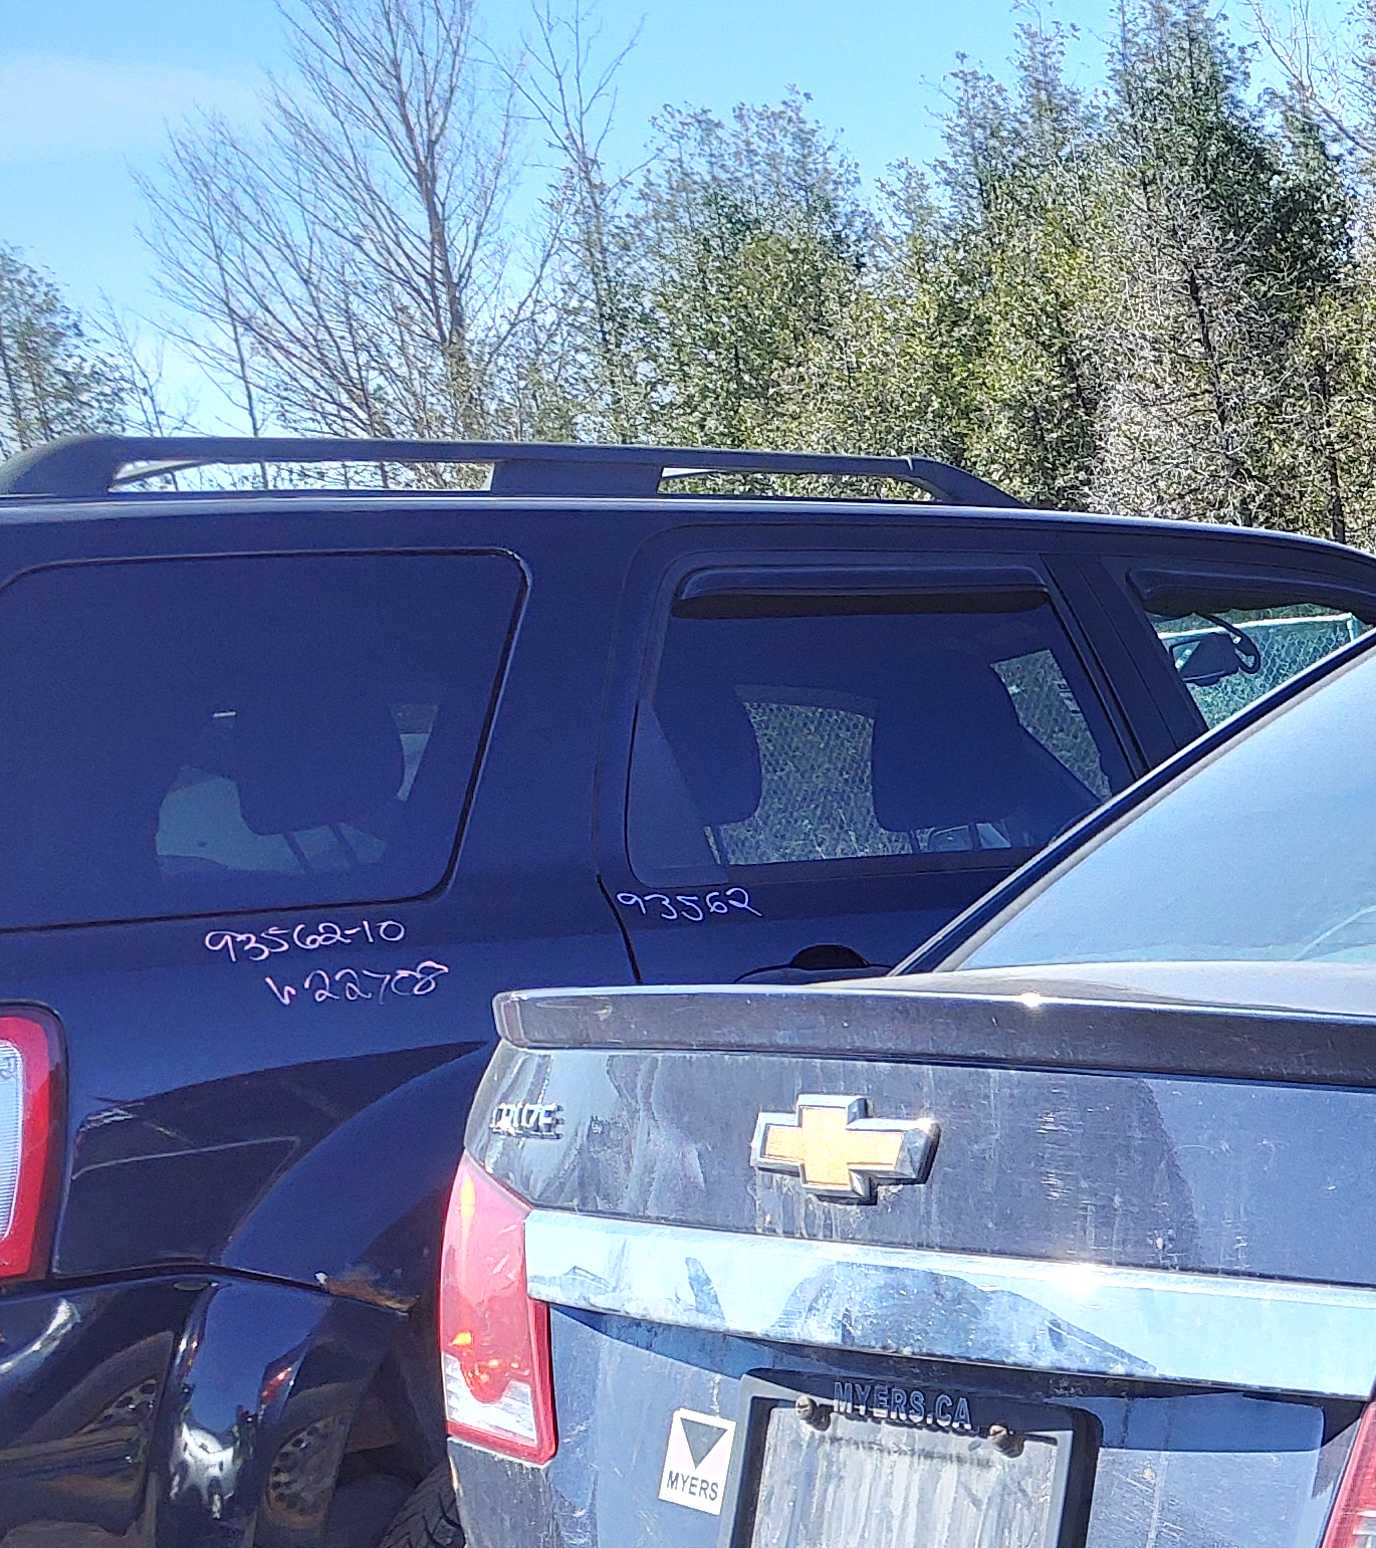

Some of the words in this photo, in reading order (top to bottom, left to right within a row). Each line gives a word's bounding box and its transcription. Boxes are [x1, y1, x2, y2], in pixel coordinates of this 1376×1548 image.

[616, 887, 764, 922] 93562
[204, 919, 406, 963] 93562-10
[832, 1380, 973, 1432] MYERS.CA
[665, 1469, 720, 1502] MYERS
